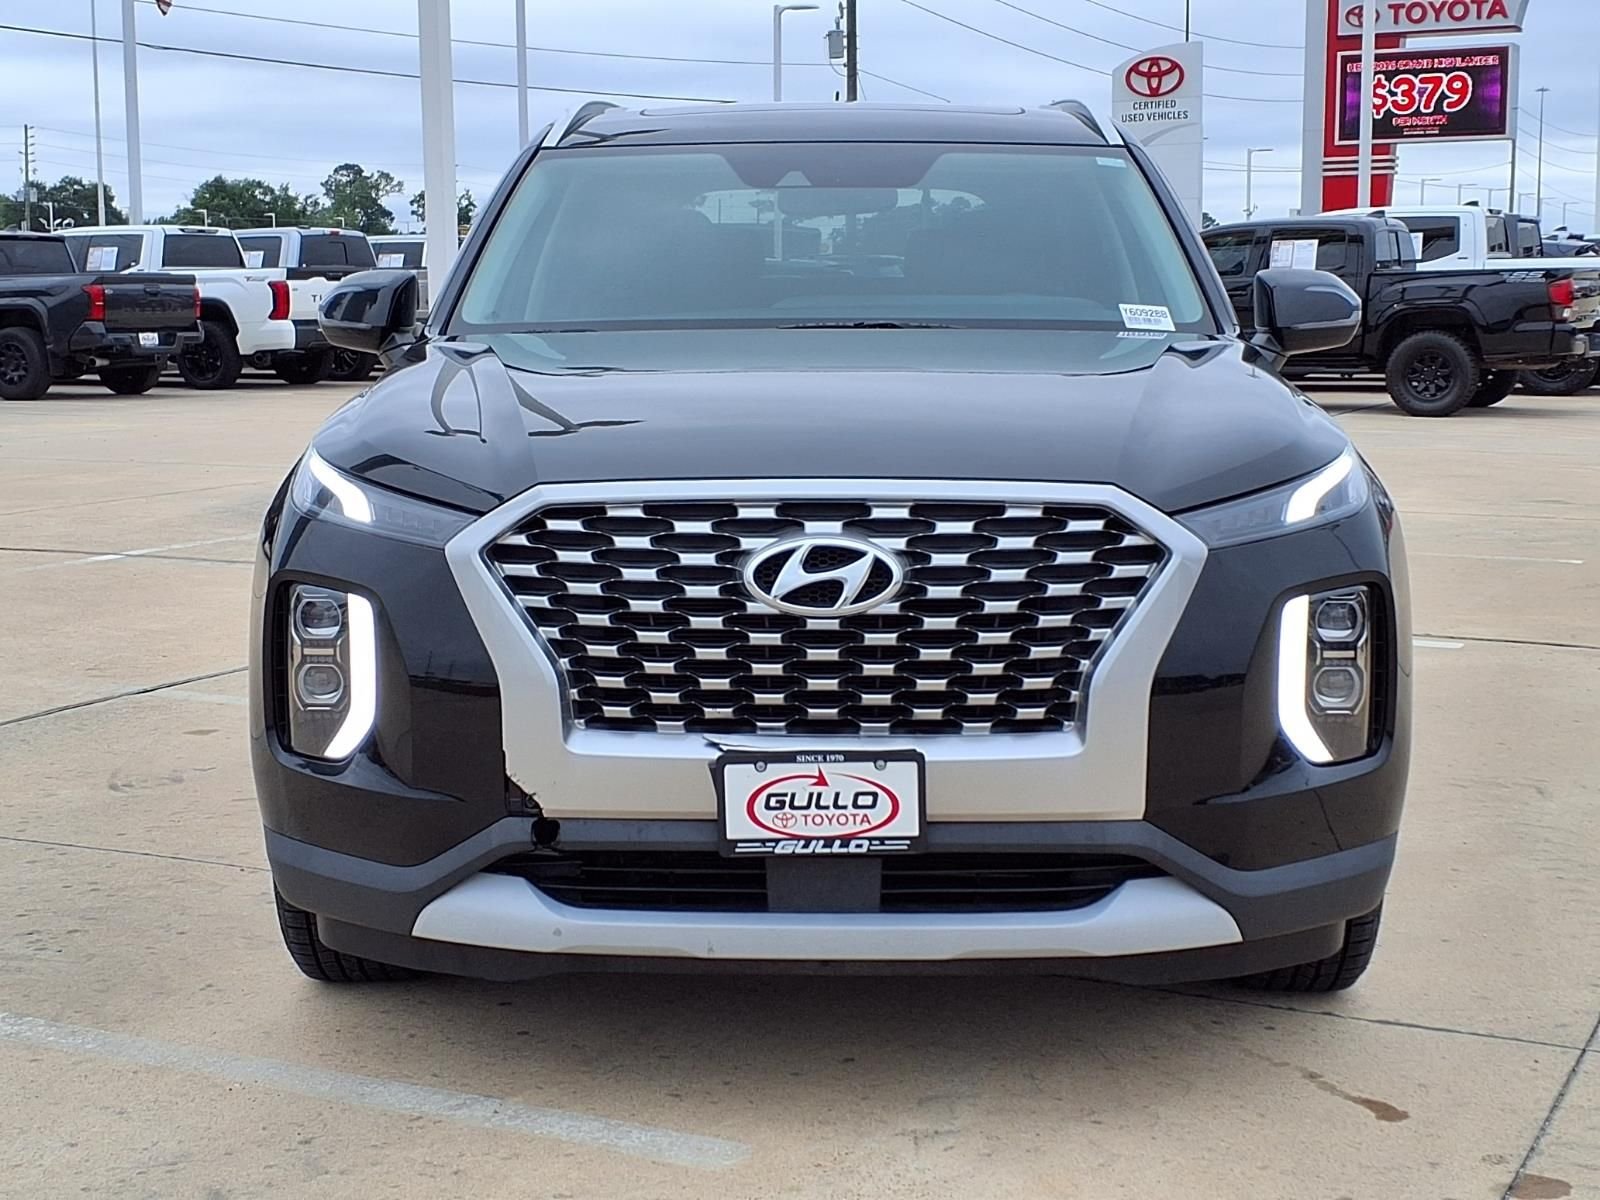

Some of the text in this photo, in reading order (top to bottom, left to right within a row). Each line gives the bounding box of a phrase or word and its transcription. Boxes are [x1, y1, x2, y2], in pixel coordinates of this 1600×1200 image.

[1387, 0, 1509, 25] TOYOTA
[1372, 71, 1472, 118] $379
[1132, 99, 1177, 111] CERTIFIED
[1121, 110, 1189, 123] USED VEHICLES
[796, 754, 845, 763] SINCE 1970
[763, 791, 879, 811] GULLO
[800, 813, 872, 827] TOYOTA
[774, 839, 870, 854] GULLO
